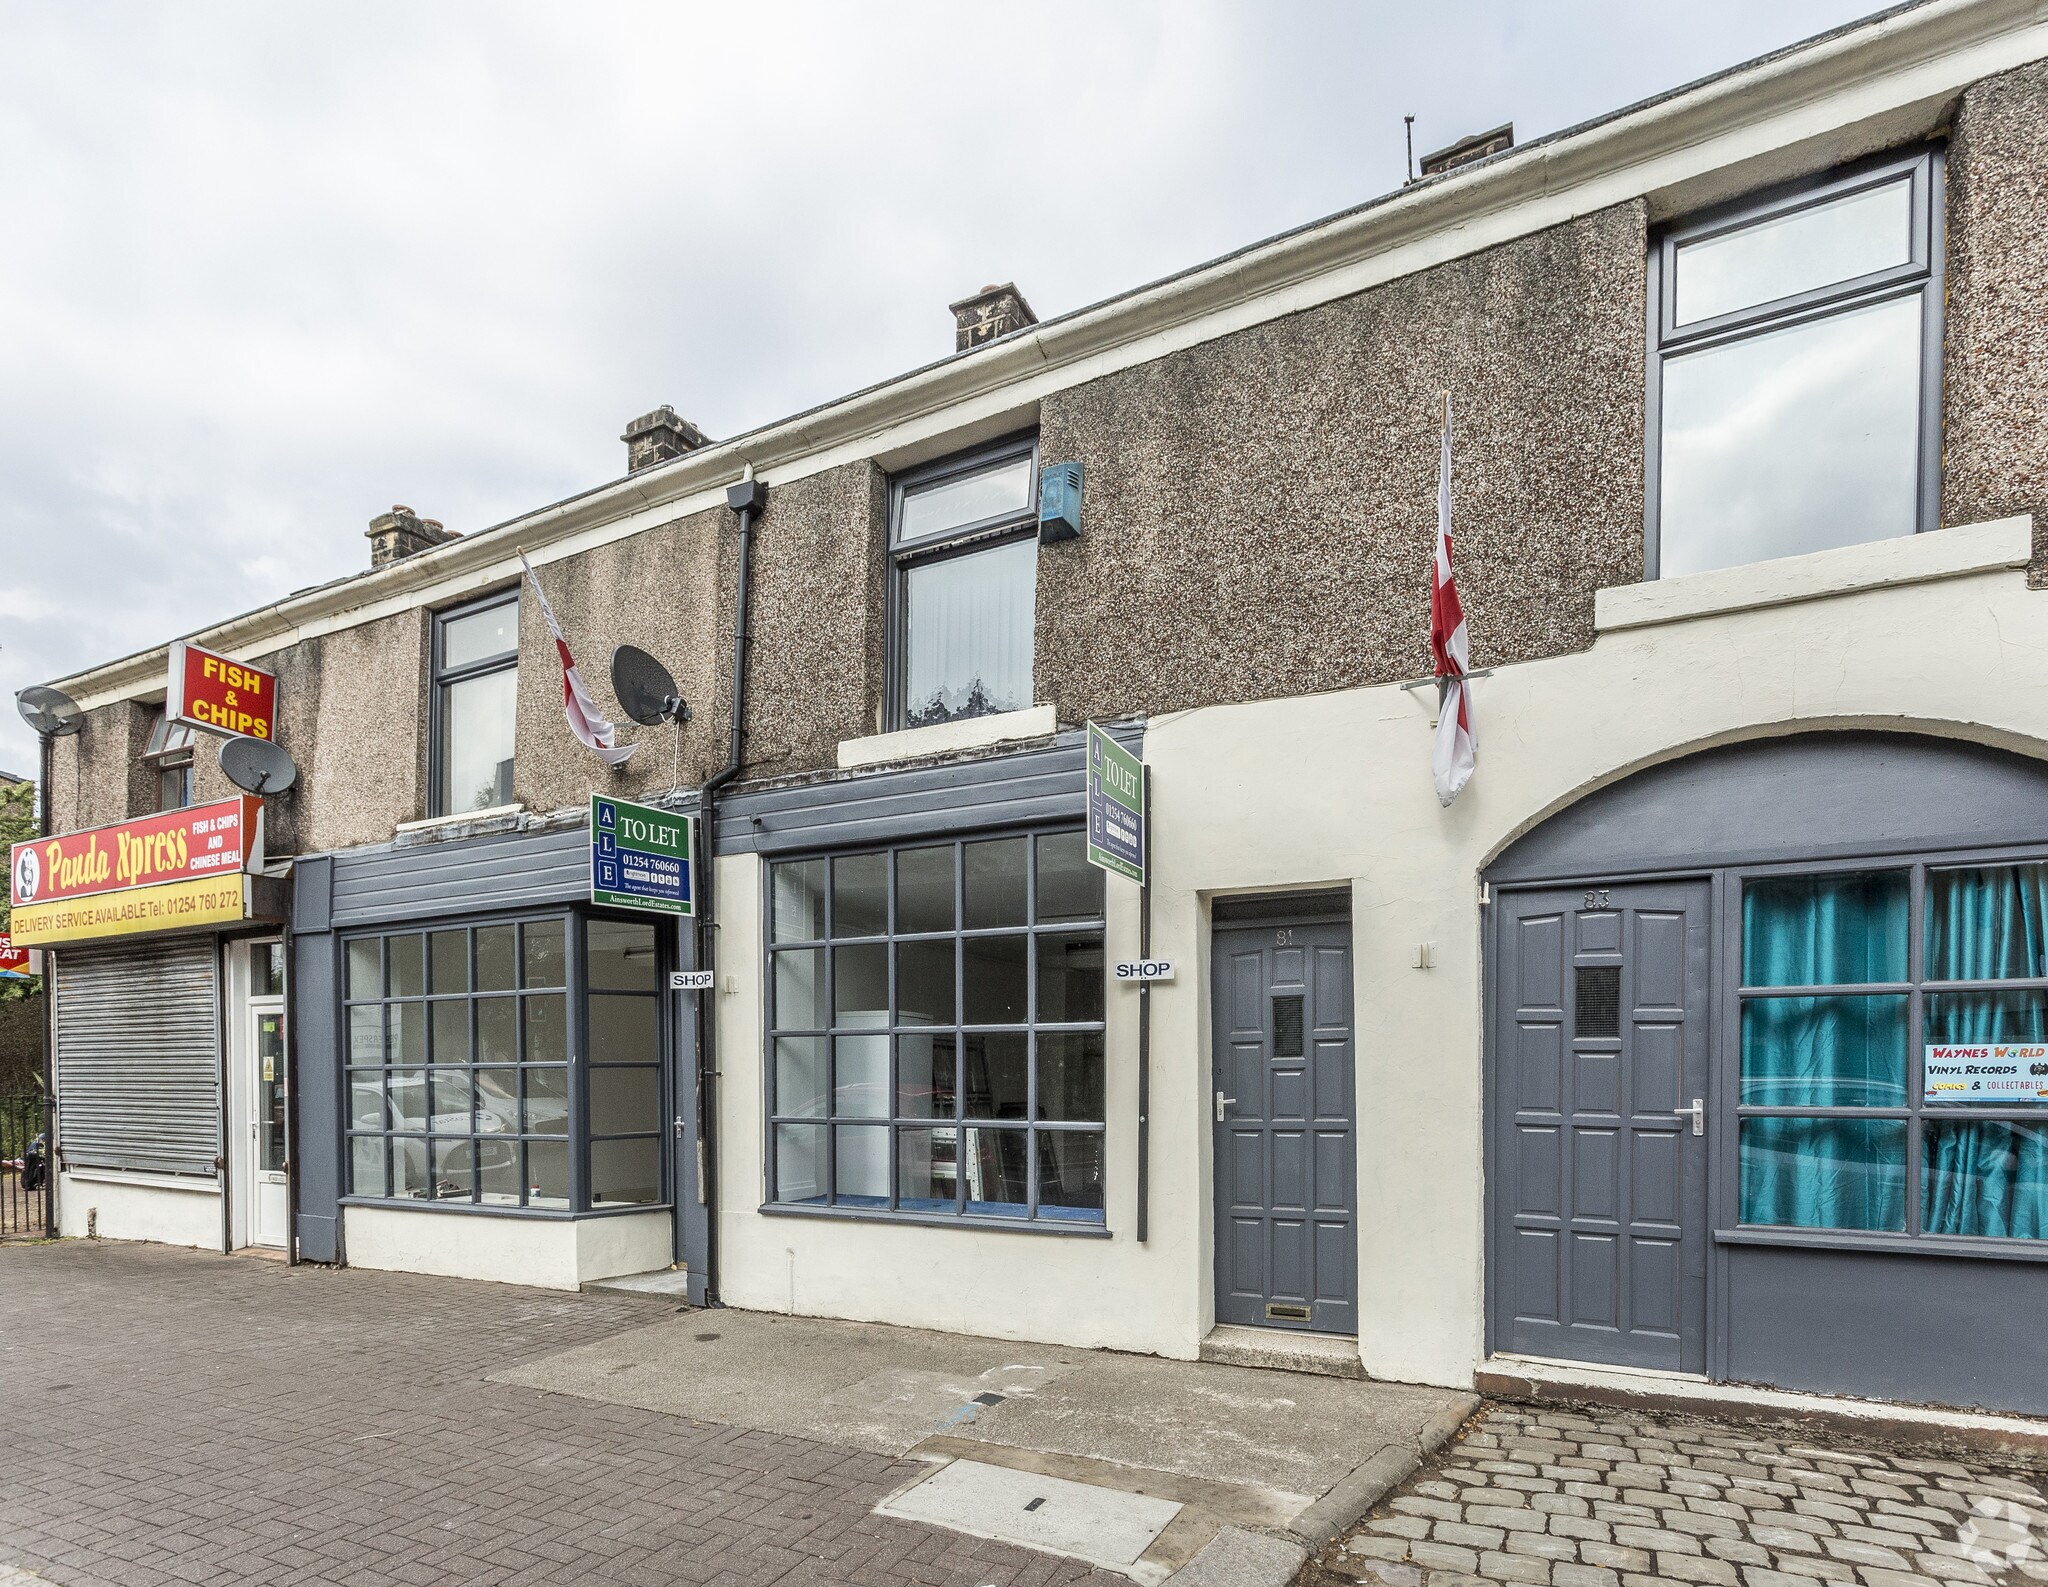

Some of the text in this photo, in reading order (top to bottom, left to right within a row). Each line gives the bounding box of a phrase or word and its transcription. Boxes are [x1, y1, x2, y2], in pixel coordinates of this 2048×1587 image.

[204, 656, 260, 694] FISH
[225, 690, 238, 706] &
[192, 699, 268, 738] CHIPS
[1104, 755, 1138, 800] TO LET
[1094, 742, 1101, 834] A L E
[192, 813, 239, 835] FISH & CHIPS
[620, 816, 680, 848] TO LET
[207, 834, 224, 850] AND
[602, 808, 613, 881] A L E
[46, 827, 188, 892] Panda Xpress
[190, 850, 241, 870] CHINESE MEAL
[622, 854, 680, 874] 01254 760660
[610, 894, 682, 911] AinsworthLordEstates.com
[1584, 890, 1610, 910] 83
[14, 890, 238, 934] DELIVERY SERVICE AVAILABLE Tel: 01254 760 272
[1276, 929, 1293, 946] 81
[673, 974, 712, 986] SHOP
[1116, 962, 1170, 978] SHOP
[1932, 1047, 1988, 1058] WAYNES
[1928, 1065, 2018, 1075] VINYL RECORDS
[1932, 1080, 2044, 1091] COMICS & COLLECTABLES
